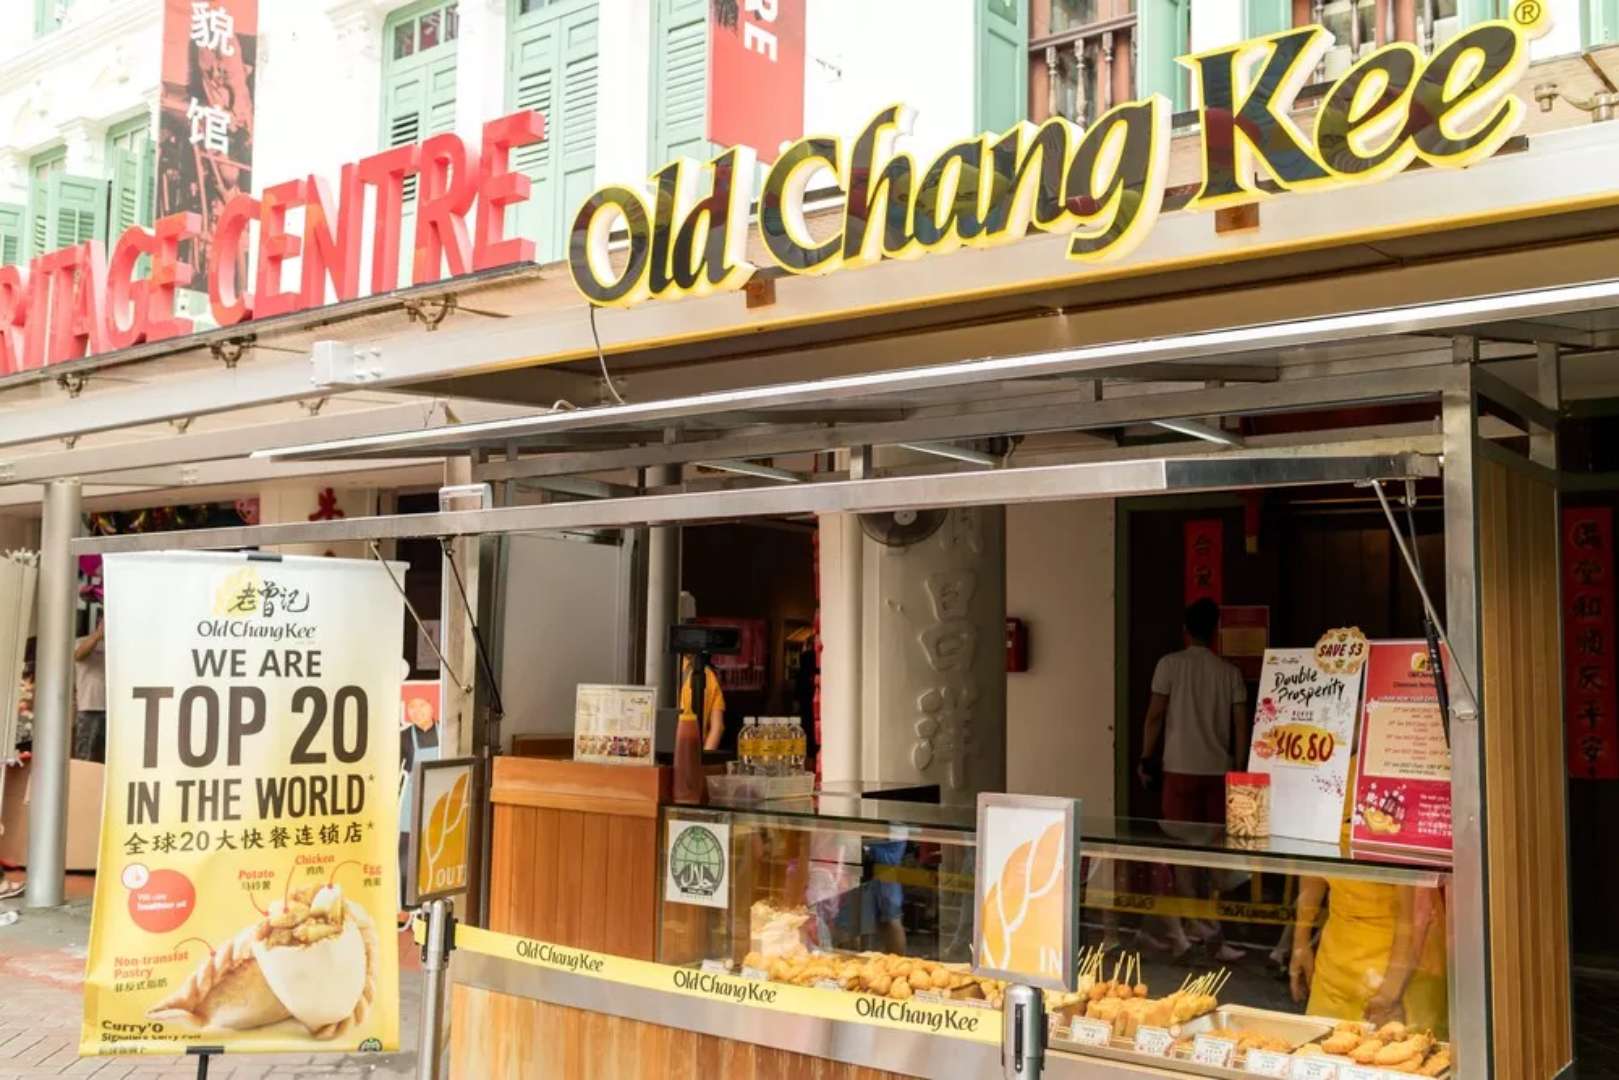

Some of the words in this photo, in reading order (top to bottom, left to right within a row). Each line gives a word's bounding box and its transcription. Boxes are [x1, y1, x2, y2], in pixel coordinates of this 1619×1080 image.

[569, 146, 752, 306] Old
[759, 94, 1166, 262] Chang
[1174, 20, 1525, 209] Kee
[208, 110, 545, 327] CENTRE
[192, 649, 246, 677] WE
[258, 650, 321, 678] ARE
[1318, 644, 1347, 658] SAVE
[1348, 642, 1363, 658] $3
[1271, 665, 1318, 693] Double
[1278, 678, 1345, 707] Prosperity
[132, 686, 266, 769] TOP
[290, 685, 368, 765] 20
[1276, 731, 1334, 762] $16.80
[127, 782, 159, 824] IN
[176, 780, 241, 822] THE
[295, 853, 335, 865] Chicken
[238, 870, 275, 881] Potato
[437, 864, 464, 887] OUT
[114, 968, 153, 980] Pastry
[1040, 945, 1061, 974] IN
